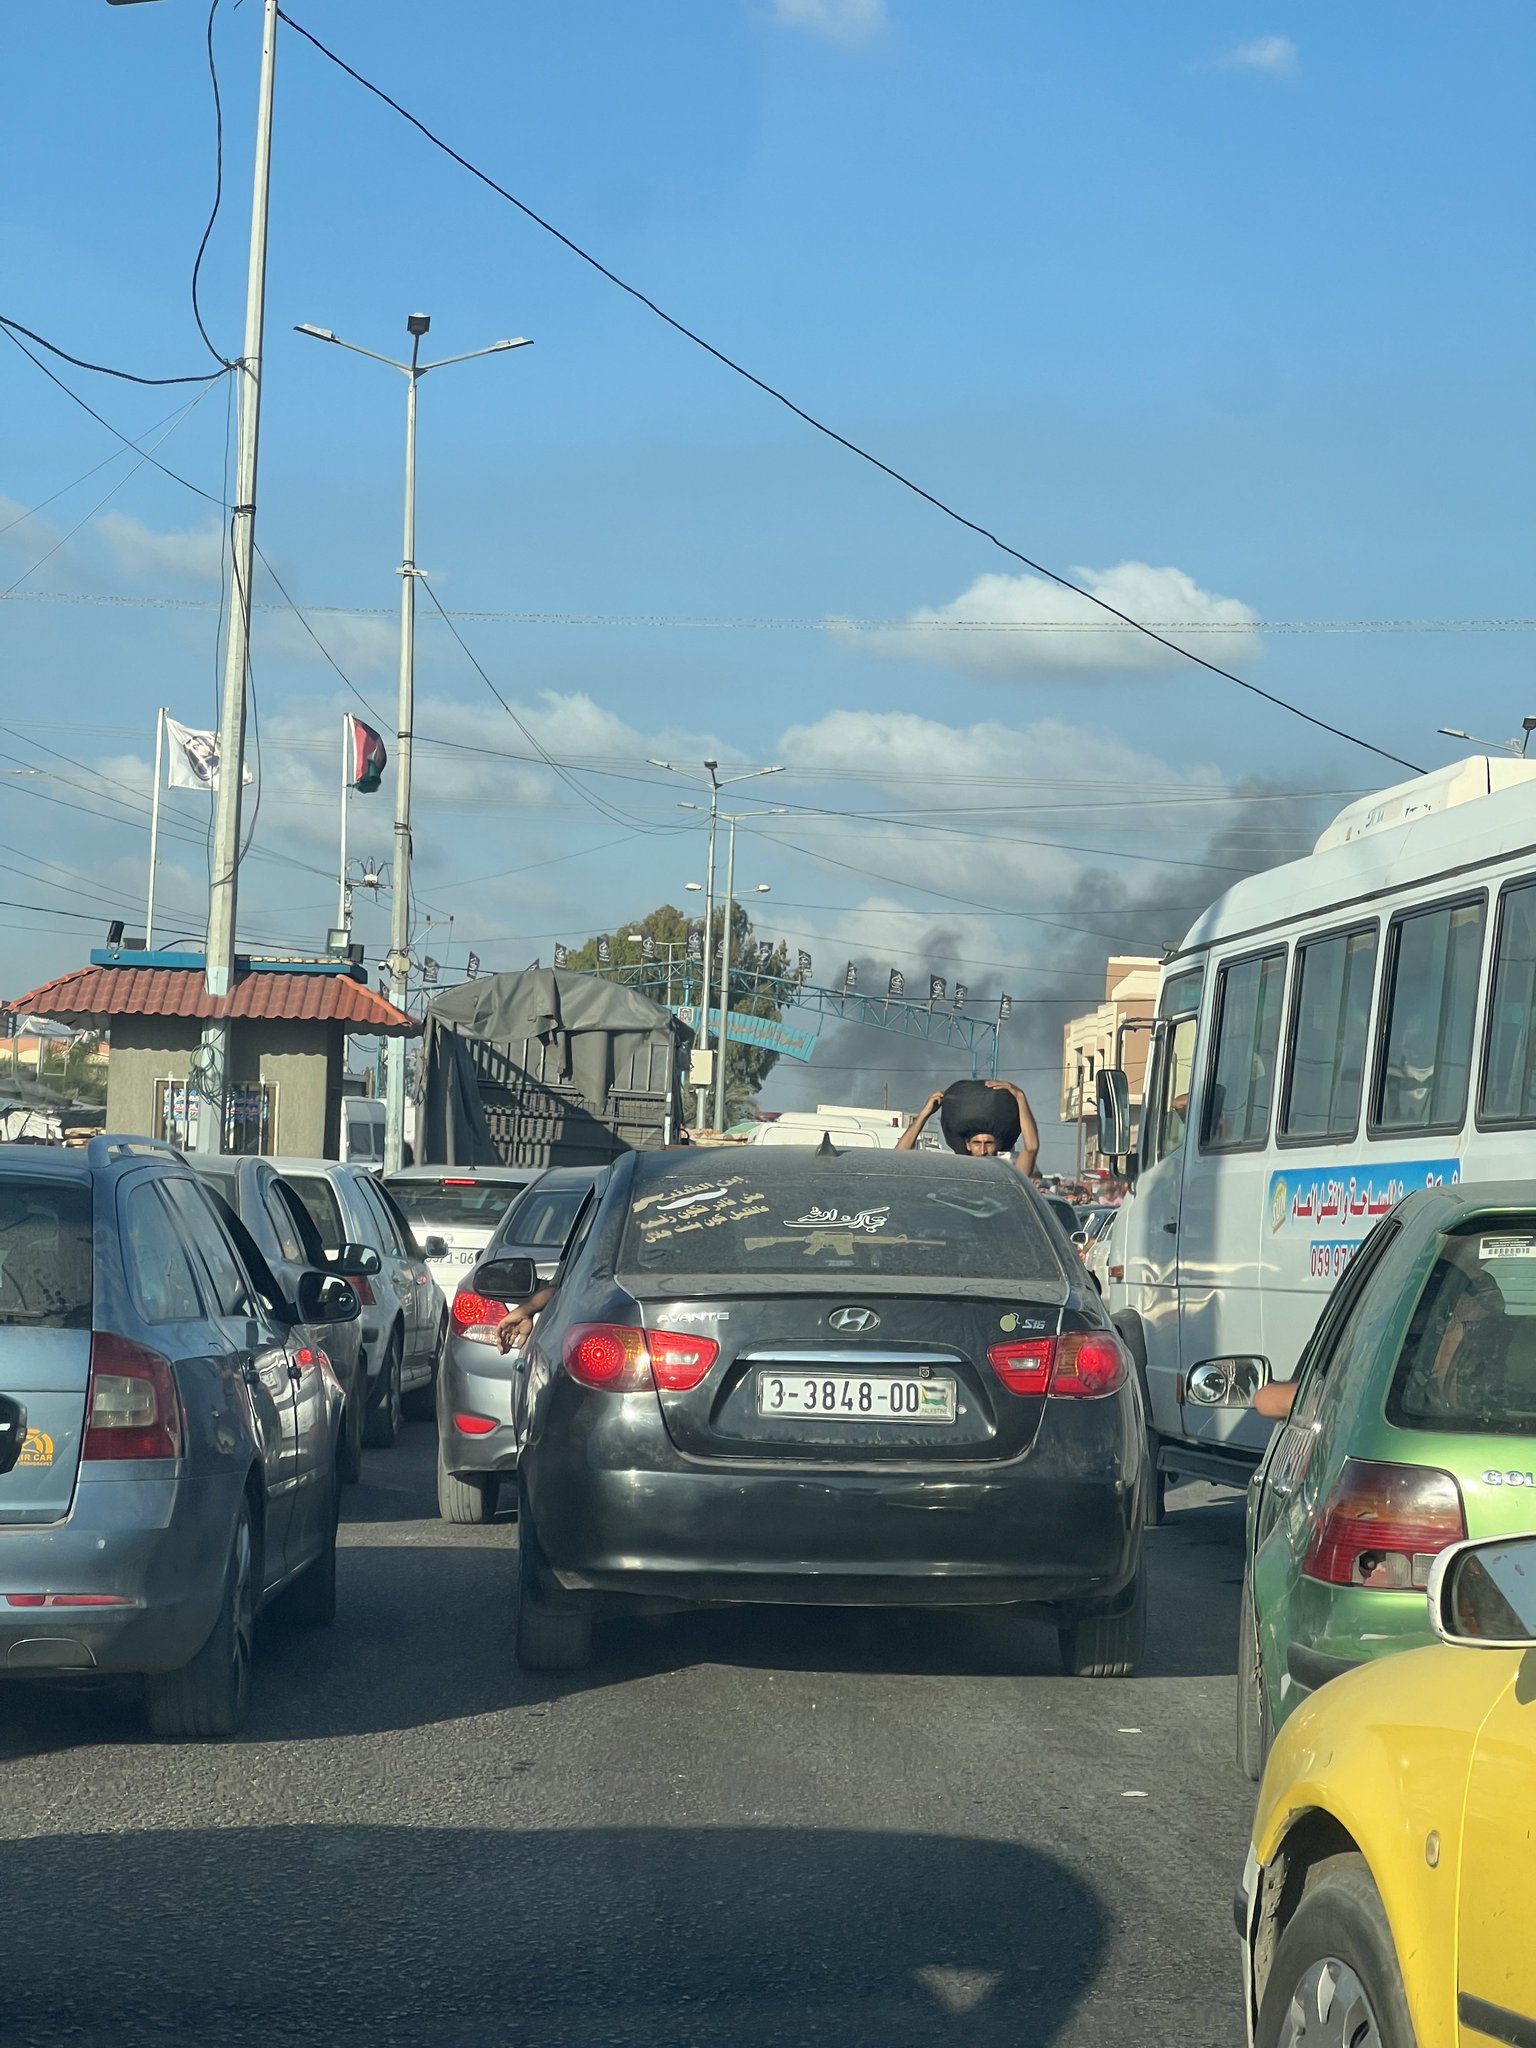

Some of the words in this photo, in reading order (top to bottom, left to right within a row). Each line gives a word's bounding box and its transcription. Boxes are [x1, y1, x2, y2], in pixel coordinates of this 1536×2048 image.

[740, 1193, 765, 1204] مش
[1291, 1182, 1318, 1225] العام
[783, 1206, 891, 1233] تبارك
[797, 1206, 839, 1222] الله
[1311, 1246, 1330, 1277] 059
[1333, 1246, 1357, 1277] 97
[657, 1311, 730, 1323] AVANTE
[770, 1379, 919, 1413] 3-3848-00
